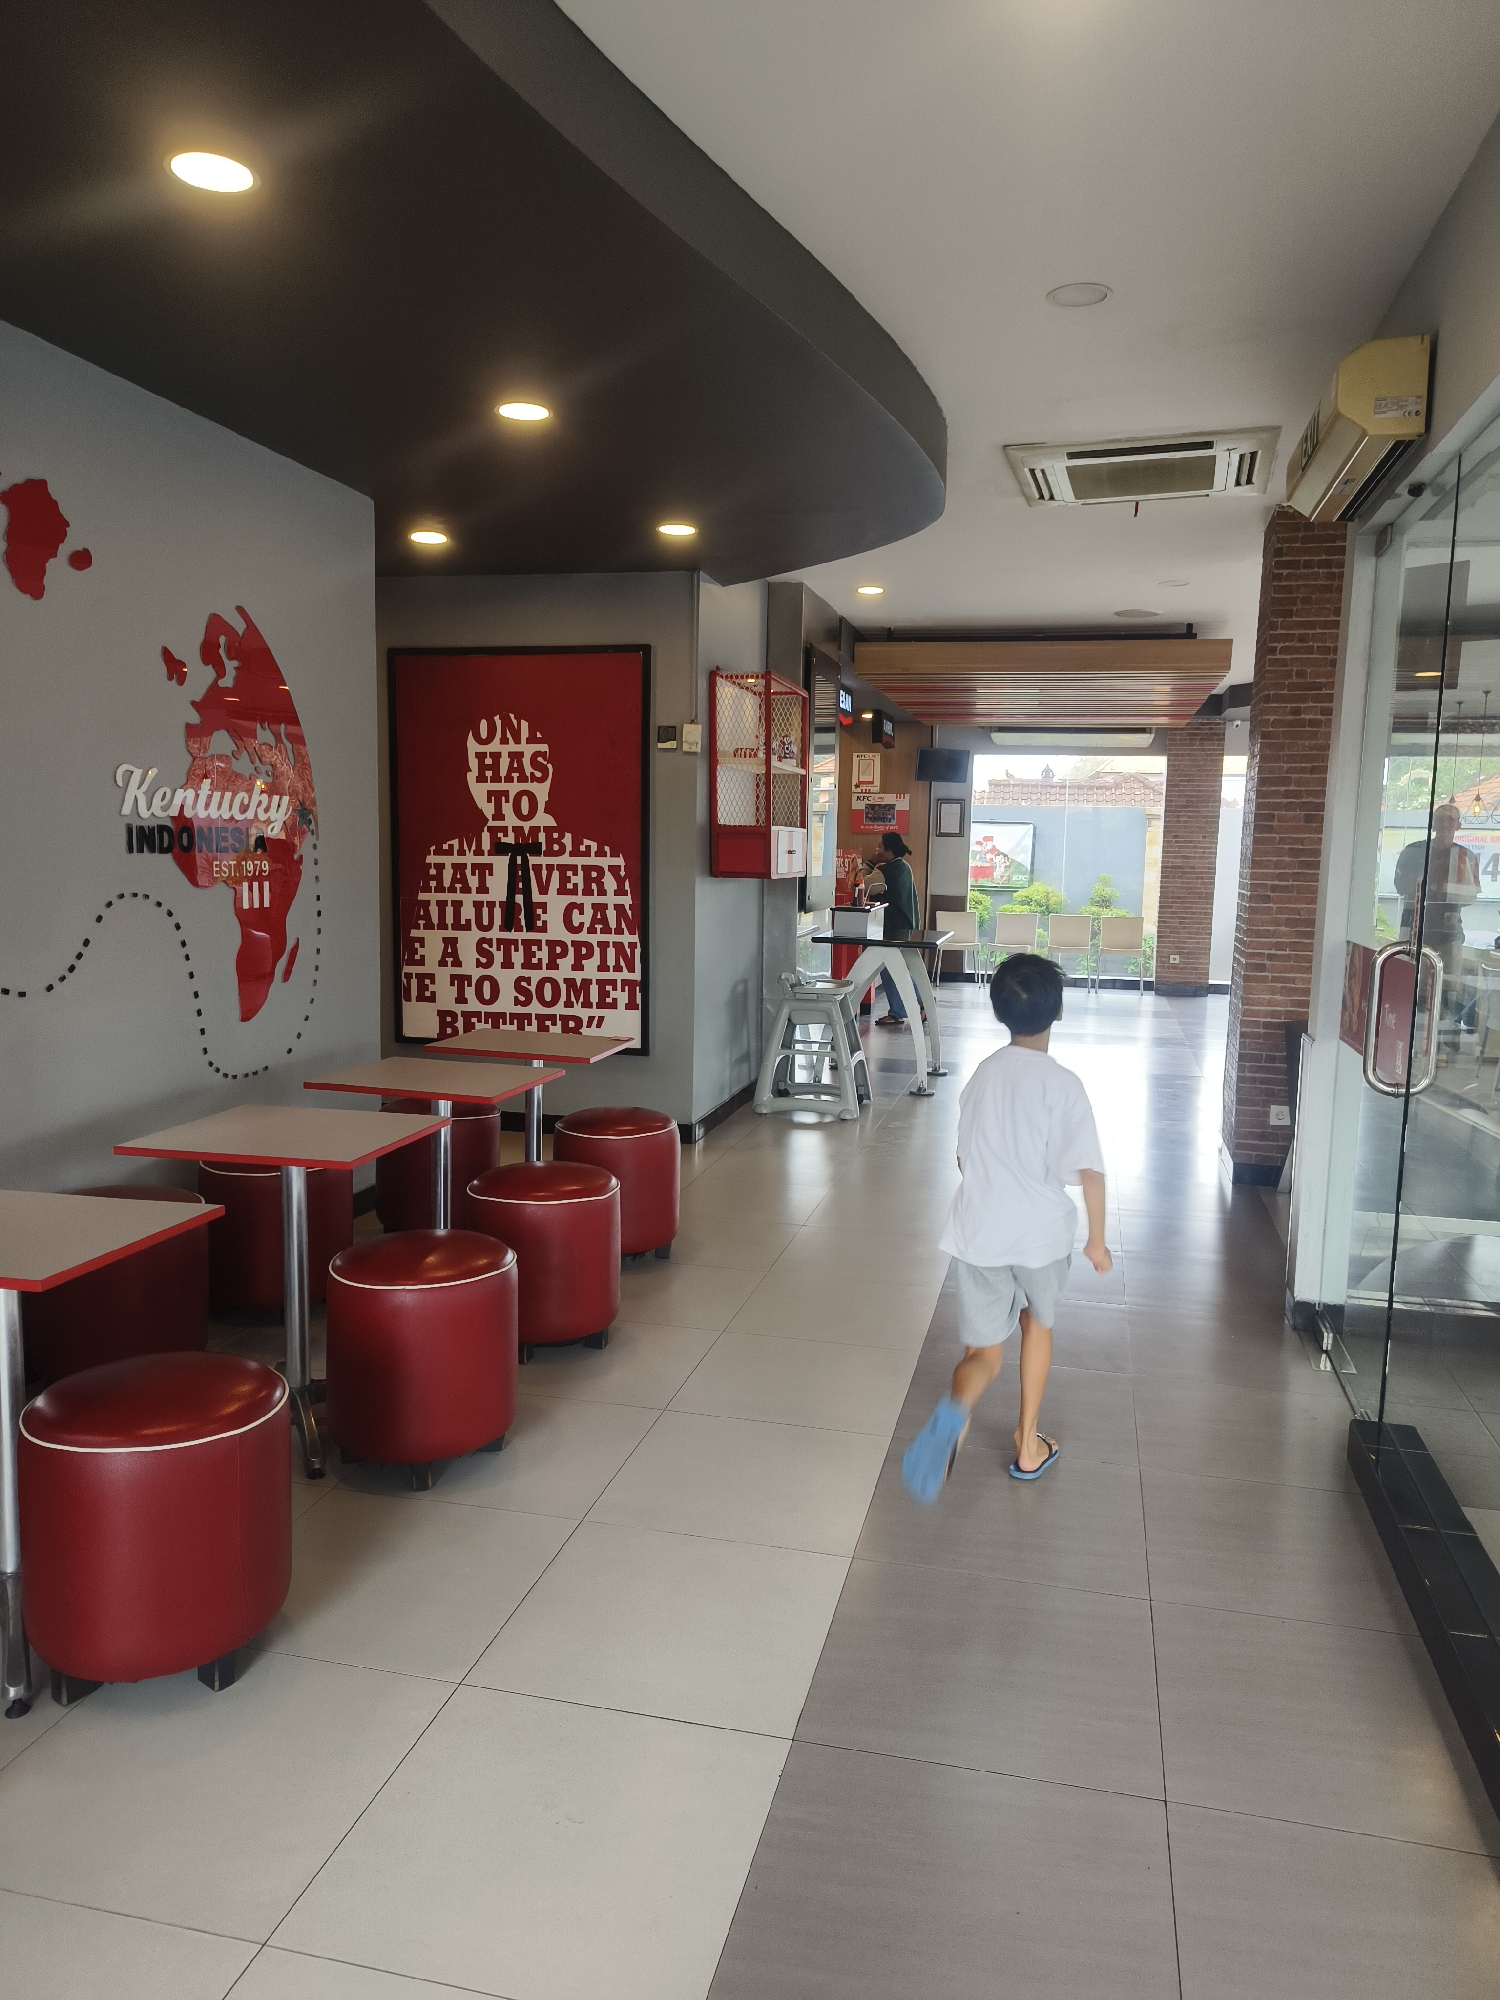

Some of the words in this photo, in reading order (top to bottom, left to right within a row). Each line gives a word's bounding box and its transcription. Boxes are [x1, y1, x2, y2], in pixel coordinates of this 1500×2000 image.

[475, 750, 549, 784] HAS
[115, 763, 293, 838] Kentucky
[487, 788, 538, 822] TO
[126, 823, 268, 855] INDONESIA
[1455, 835, 1488, 843] ORIGINAL
[213, 861, 240, 878] EST.
[241, 860, 270, 877] 1979
[514, 863, 629, 896] VERY
[563, 902, 638, 936] CAN
[438, 937, 463, 968] A
[476, 937, 638, 973] STEPPIN
[450, 974, 500, 1006] TO
[514, 975, 641, 1011] SOMET
